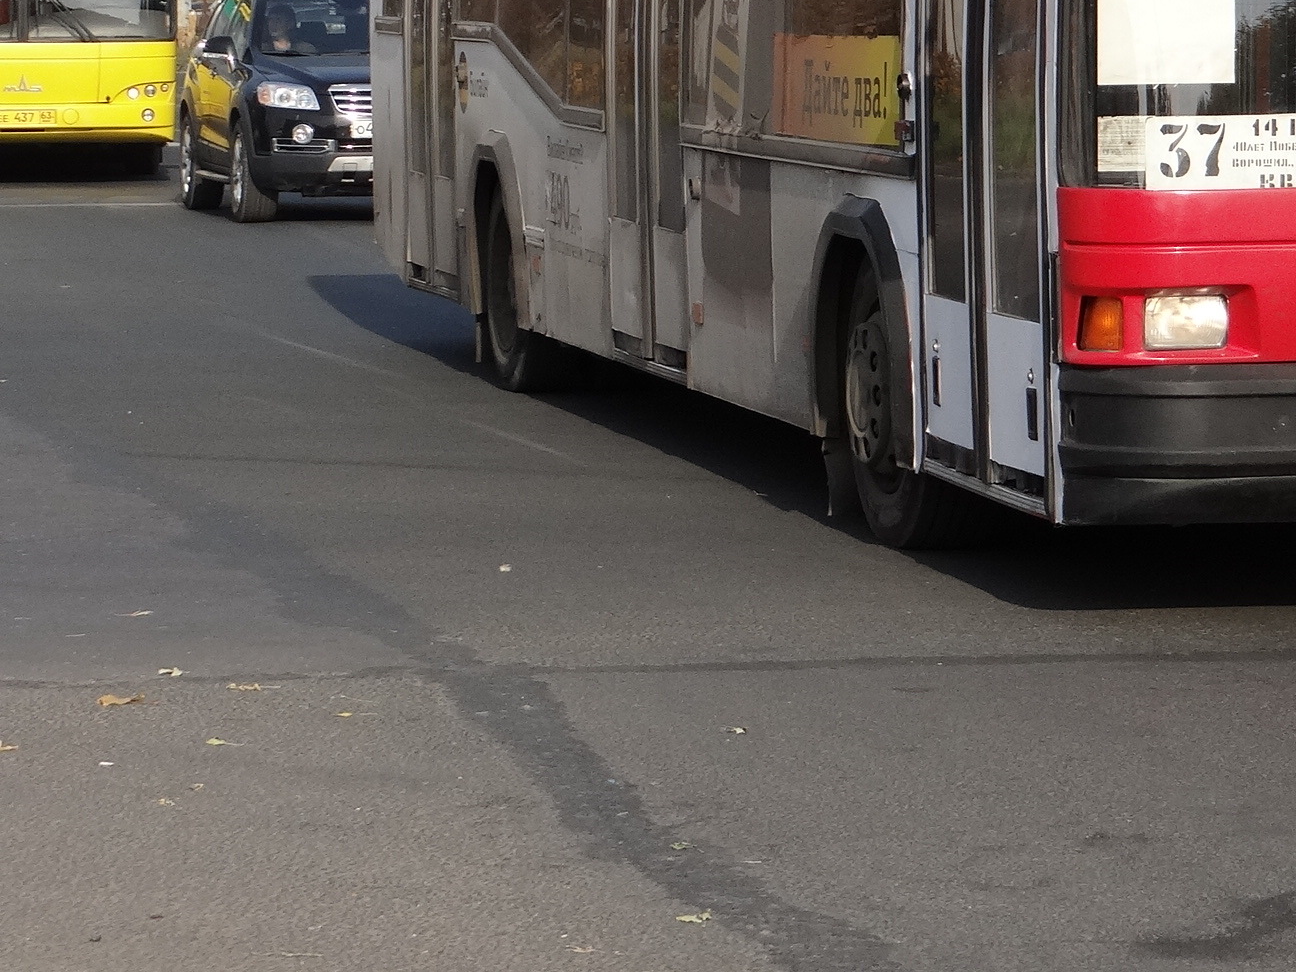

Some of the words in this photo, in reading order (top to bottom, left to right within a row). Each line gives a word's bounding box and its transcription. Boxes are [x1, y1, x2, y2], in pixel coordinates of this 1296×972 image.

[802, 59, 849, 126] Дайте
[853, 61, 887, 128] два!
[14, 112, 34, 123] 437
[41, 111, 52, 120] 63
[1252, 118, 1278, 136] 14
[1160, 122, 1226, 178] 37
